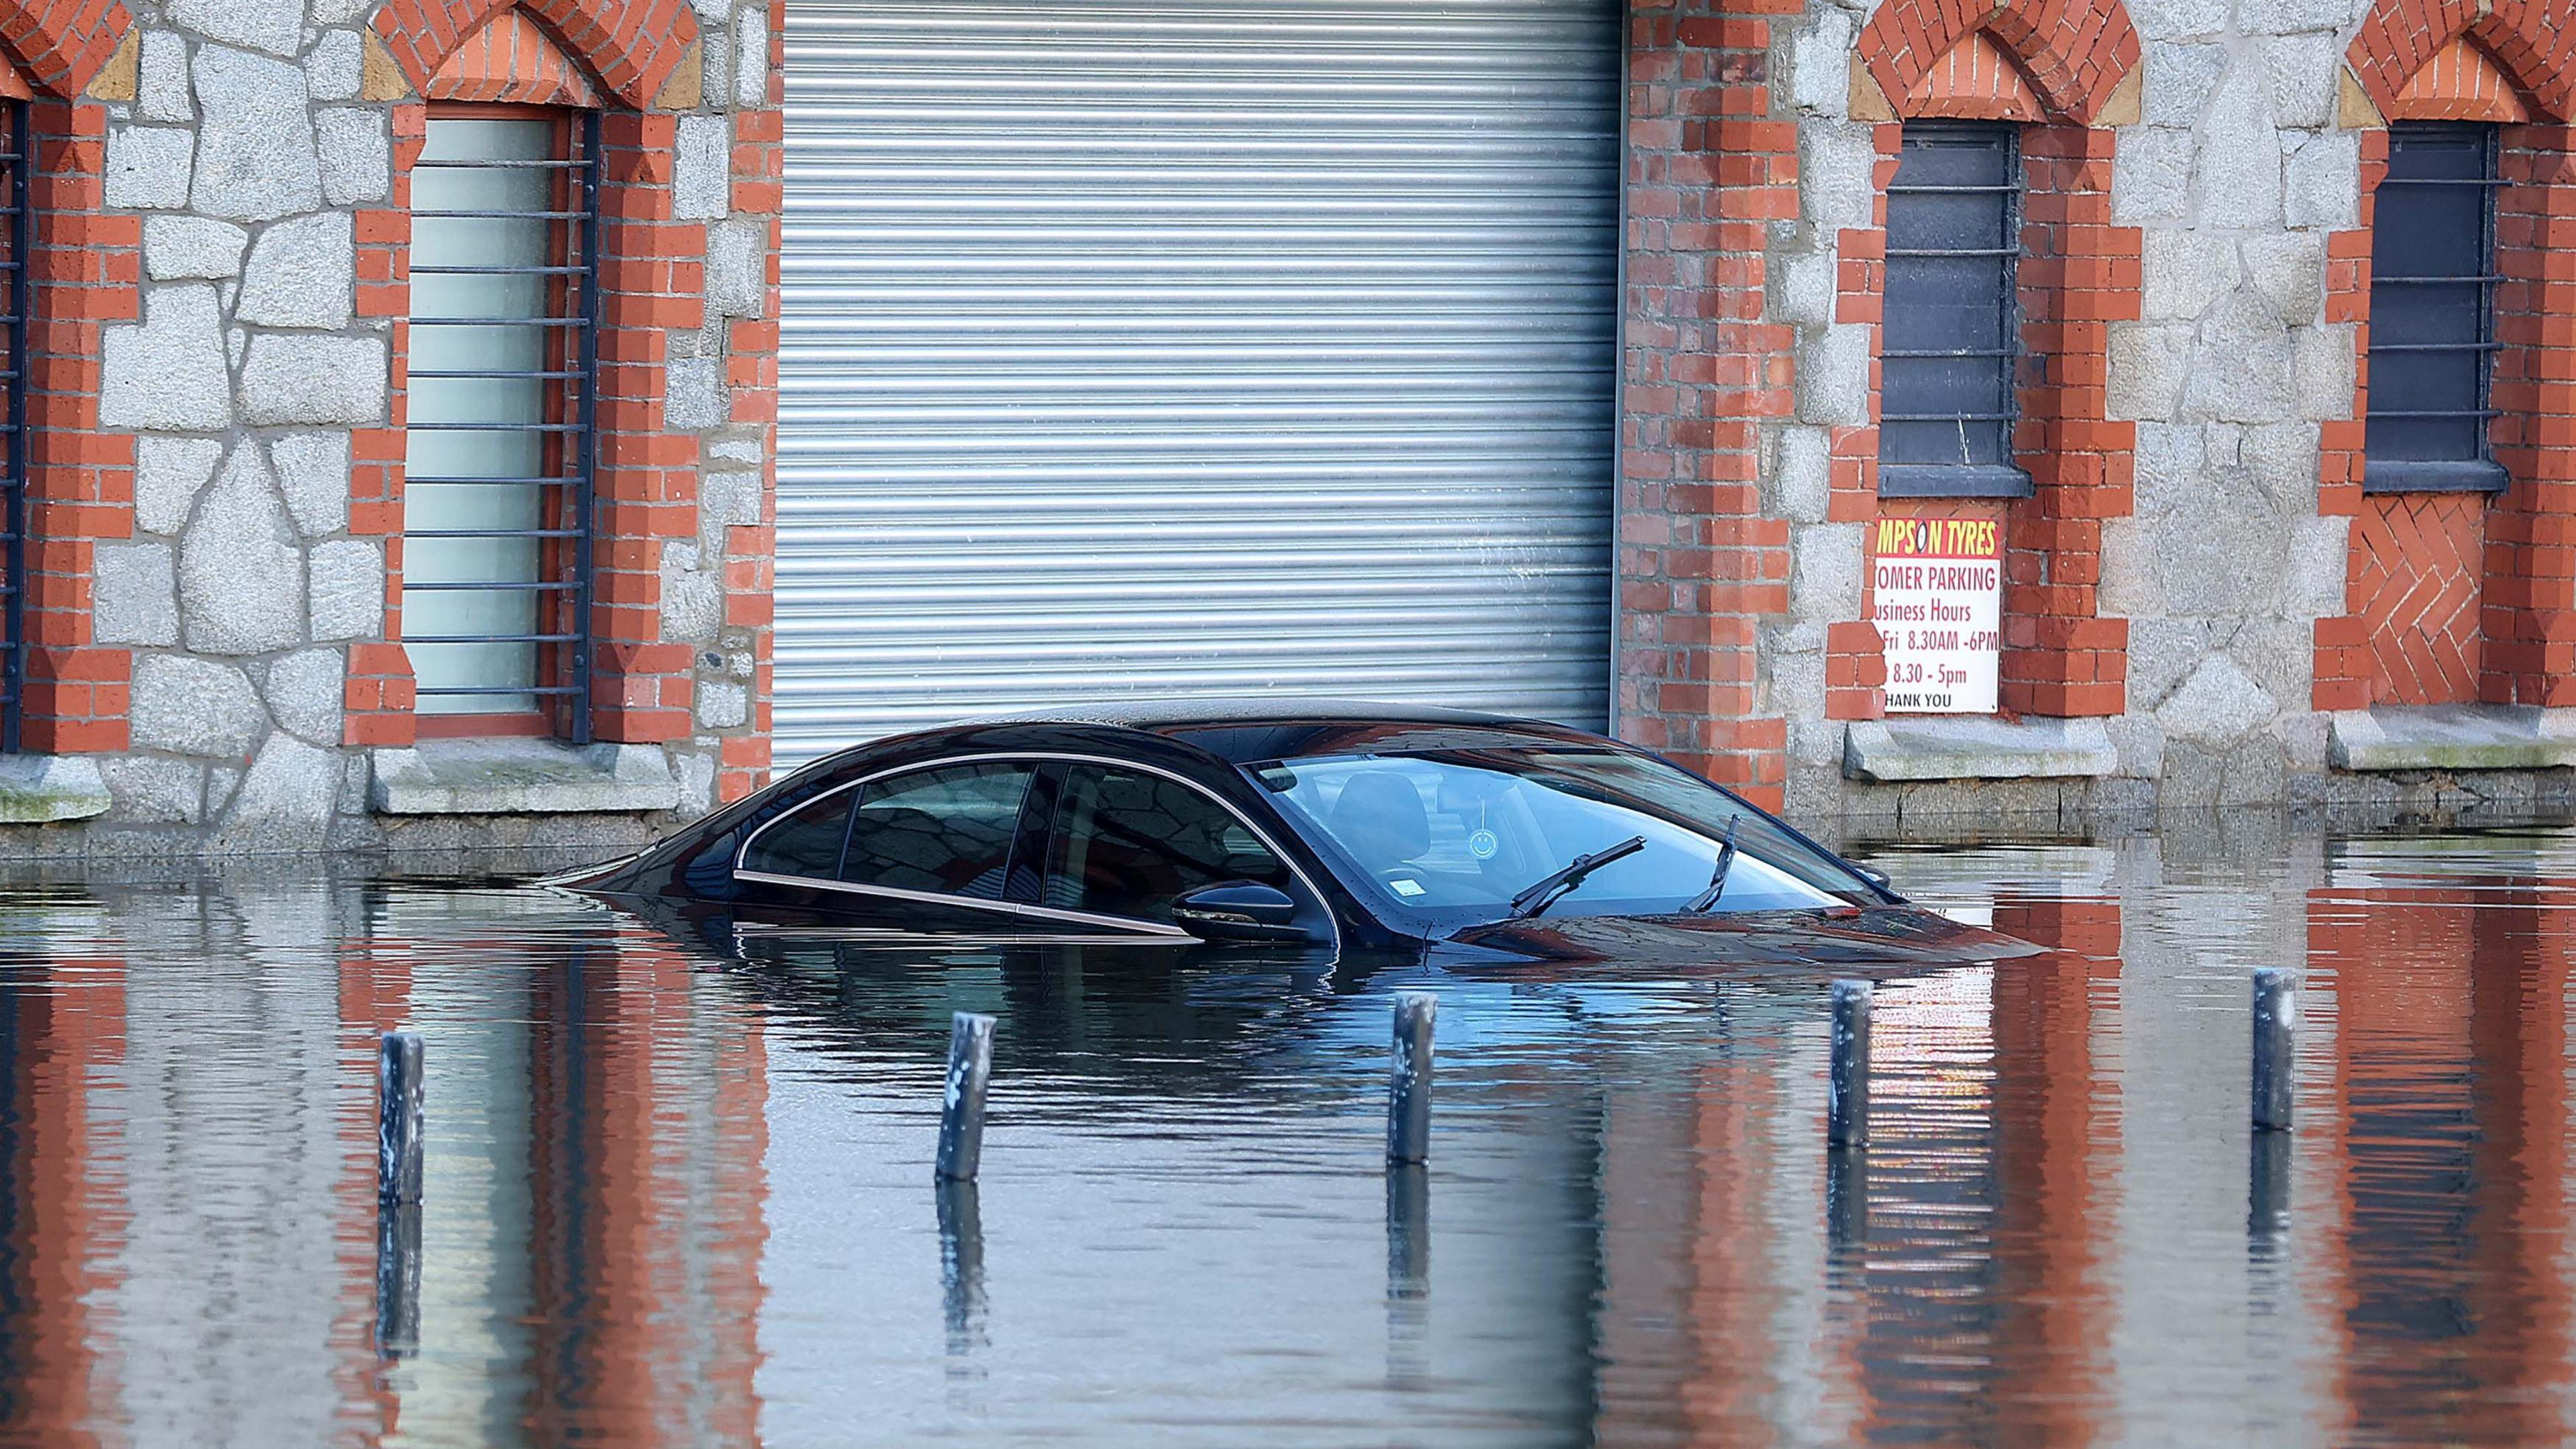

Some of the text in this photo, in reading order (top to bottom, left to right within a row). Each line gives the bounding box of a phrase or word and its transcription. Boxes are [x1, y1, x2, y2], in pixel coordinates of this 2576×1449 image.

[1947, 520, 1996, 556] TYRES
[1878, 566, 1995, 591] OMER PARKING
[1874, 598, 1971, 622] usiness Hours
[1883, 631, 1898, 650] Fri
[1908, 631, 1958, 651] 8.30AM
[1893, 663, 1923, 683] 8.30
[1938, 663, 1967, 688] 5pm
[1885, 694, 1951, 707] HANK YOU
